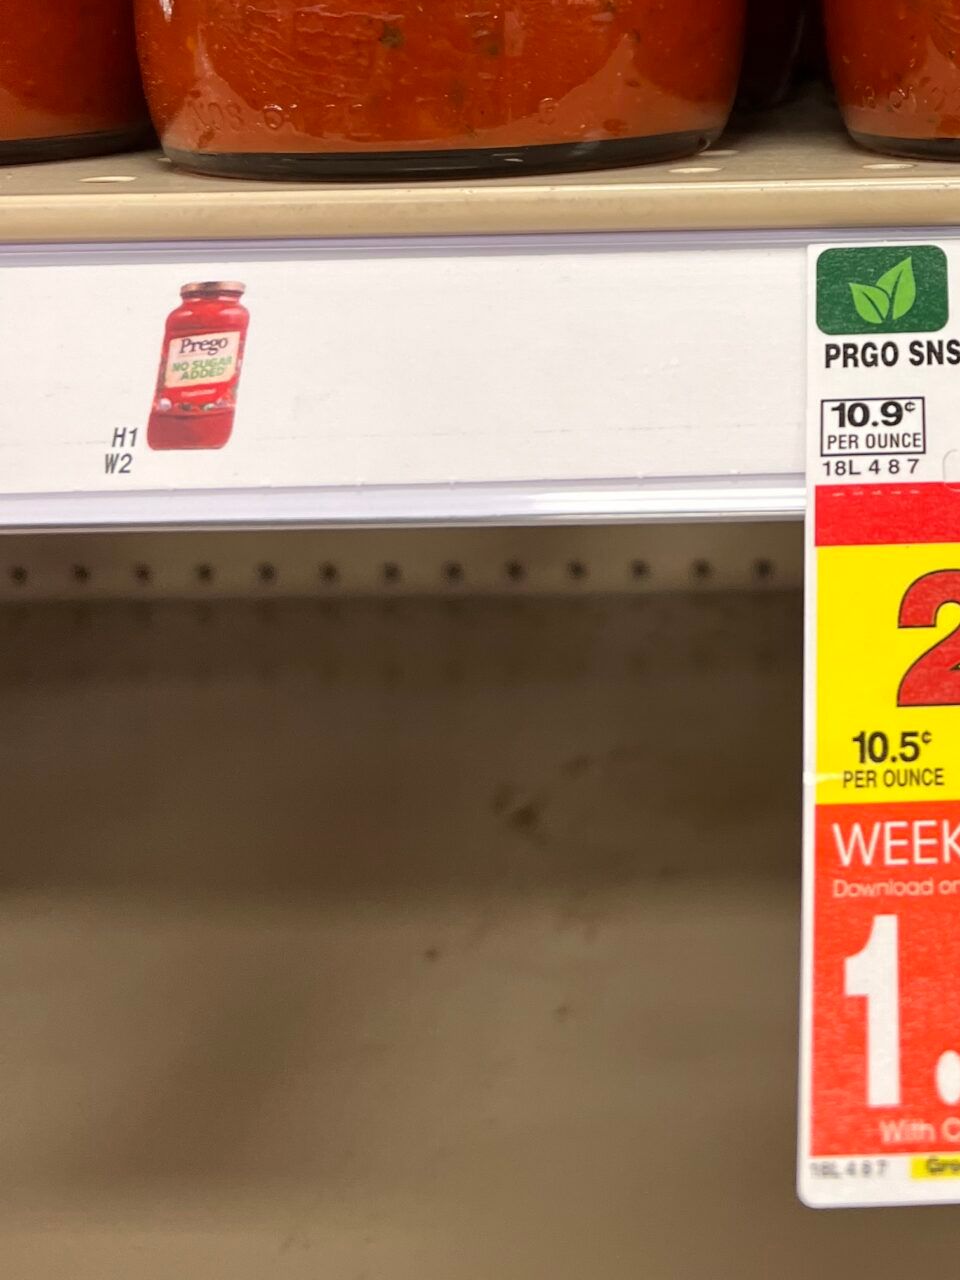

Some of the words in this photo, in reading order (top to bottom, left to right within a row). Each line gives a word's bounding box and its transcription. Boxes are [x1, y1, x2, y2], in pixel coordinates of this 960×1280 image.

[178, 337, 229, 356] Prego
[823, 341, 900, 369] PRGO
[173, 361, 189, 372] NO
[191, 355, 232, 370] SUGAR
[180, 366, 225, 381] ADDED
[112, 427, 138, 448] H1
[826, 433, 860, 451] PER
[864, 430, 923, 450] OUNCE
[104, 453, 133, 474] W2
[821, 458, 861, 477] 18L
[868, 458, 882, 476] 4
[888, 457, 901, 475] 8
[907, 457, 920, 474] 7
[842, 770, 878, 789] PER
[883, 767, 945, 788] OUNCE
[832, 877, 934, 899] Download
[880, 1119, 936, 1145] With
